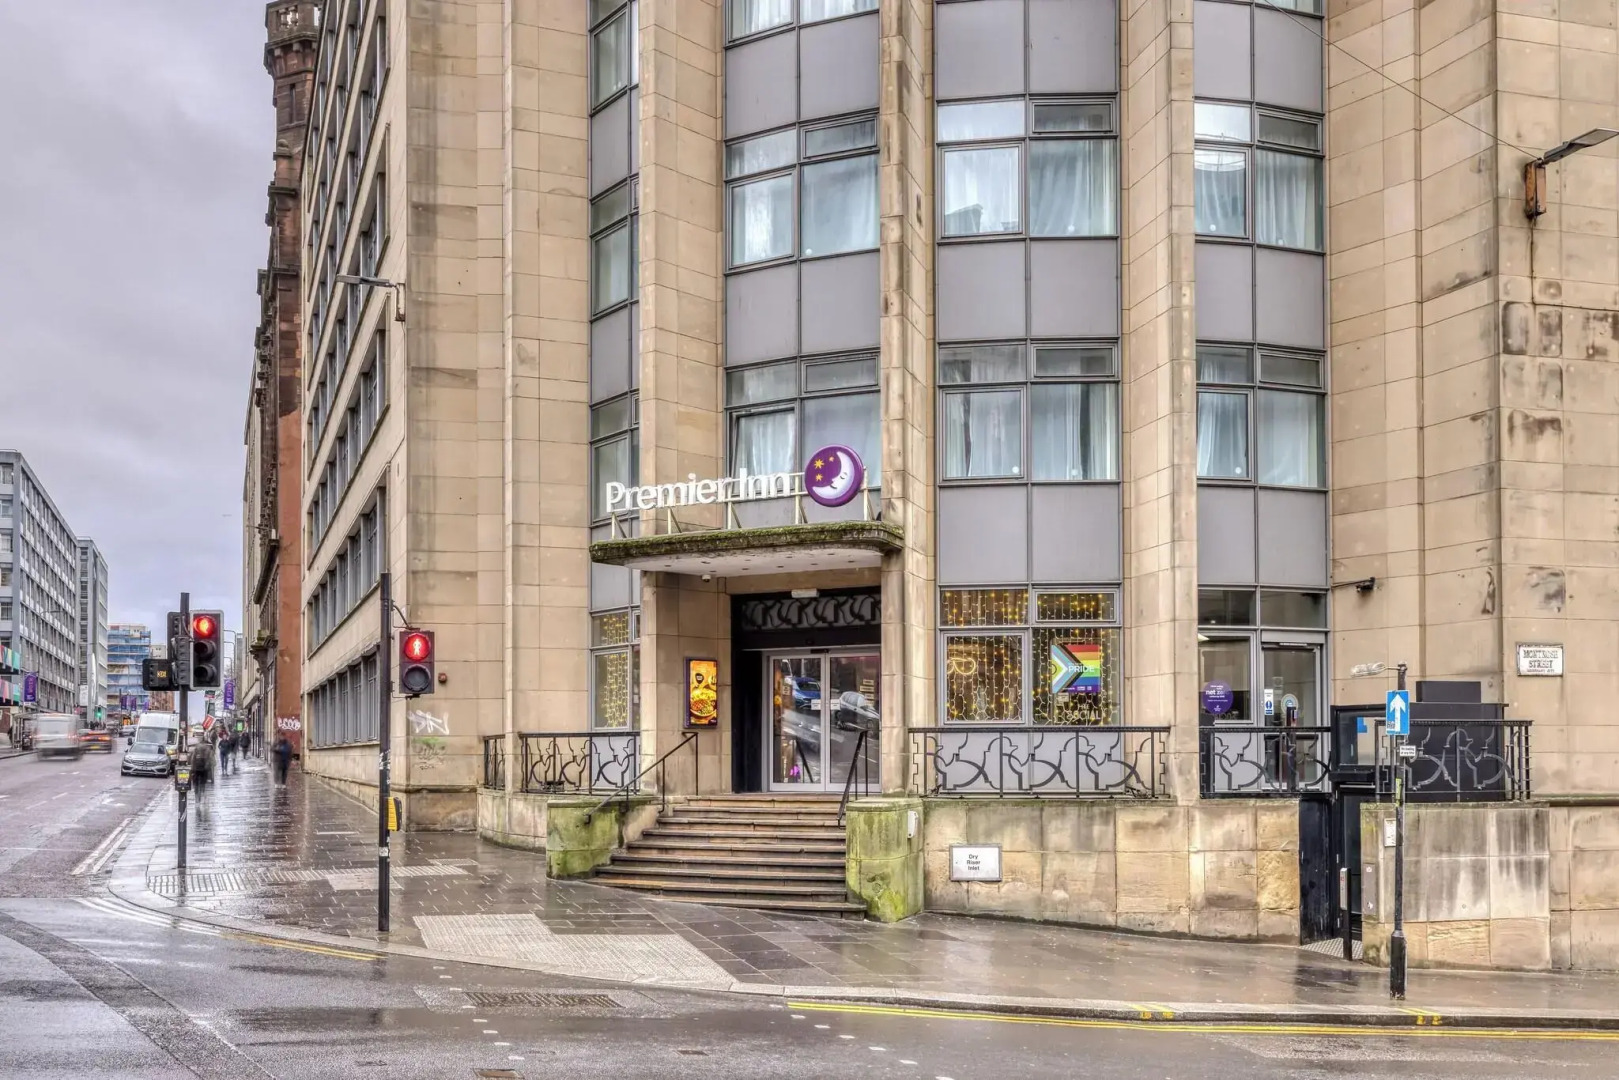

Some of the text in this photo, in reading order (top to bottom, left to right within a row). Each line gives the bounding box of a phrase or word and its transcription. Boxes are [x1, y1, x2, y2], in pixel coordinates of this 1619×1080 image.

[606, 468, 790, 513] Premier Inn
[1068, 665, 1095, 673] PRIDE
[1529, 659, 1553, 669] STREET
